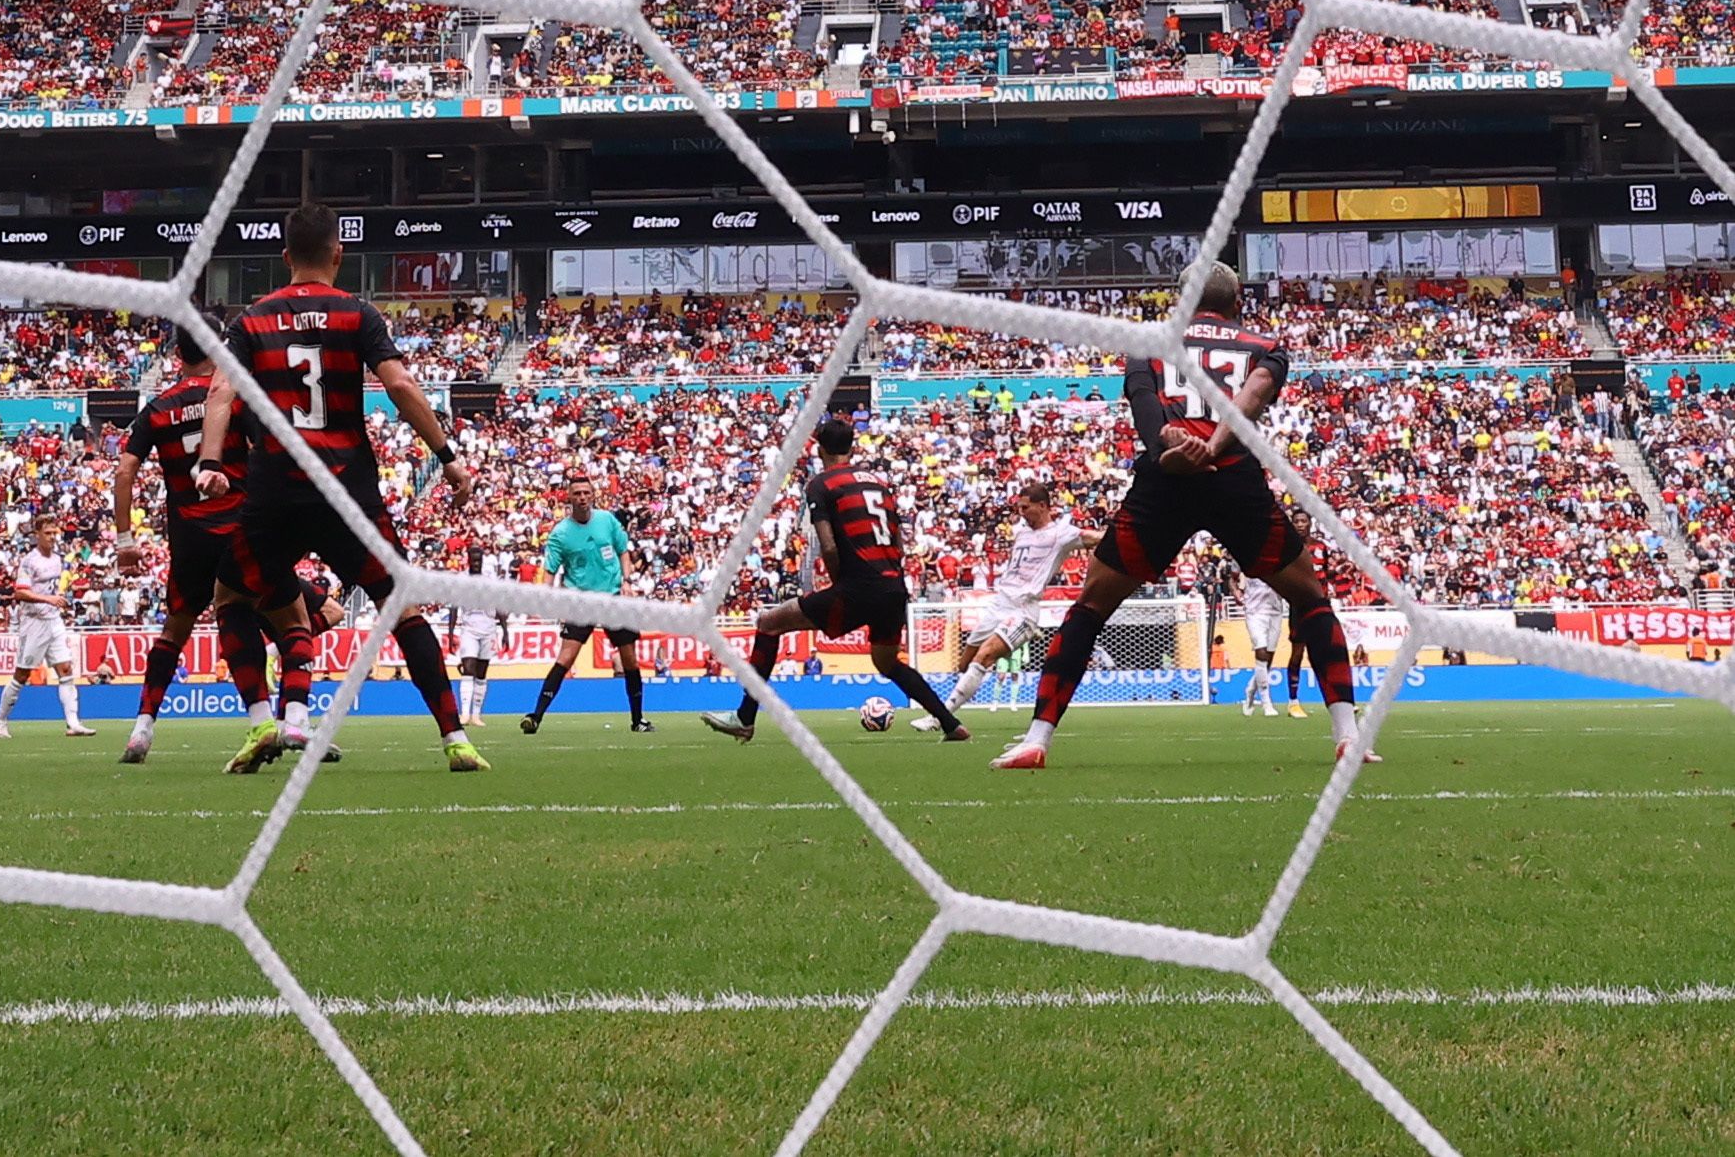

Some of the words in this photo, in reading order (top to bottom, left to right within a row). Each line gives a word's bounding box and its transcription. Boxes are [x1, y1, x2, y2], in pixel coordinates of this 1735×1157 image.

[1466, 71, 1527, 90] DUPER
[1535, 70, 1562, 88] 85
[991, 85, 1029, 103] DAN
[1033, 81, 1109, 102] MARINO
[310, 103, 405, 122] OFFERDAHL
[409, 100, 436, 118] 56
[560, 96, 617, 113] MARK
[622, 94, 695, 112] CLAYTO
[715, 92, 741, 110] 83
[51, 109, 118, 128] BETTERS
[123, 109, 148, 126] 75
[872, 210, 920, 223] Lenovo
[973, 206, 999, 222] PIF
[1033, 201, 1082, 218] QATAR
[1046, 213, 1082, 222] AIRWAYS
[1115, 201, 1162, 219] VISA
[410, 221, 442, 234] airbnb
[481, 219, 513, 229] ULTRA
[633, 216, 680, 229] Betano
[2, 231, 47, 243] Lenovo
[100, 227, 126, 242] PIF
[236, 223, 281, 240] VISA
[293, 311, 328, 330] ORTIZ
[286, 344, 328, 430] 3
[862, 490, 891, 545] 5
